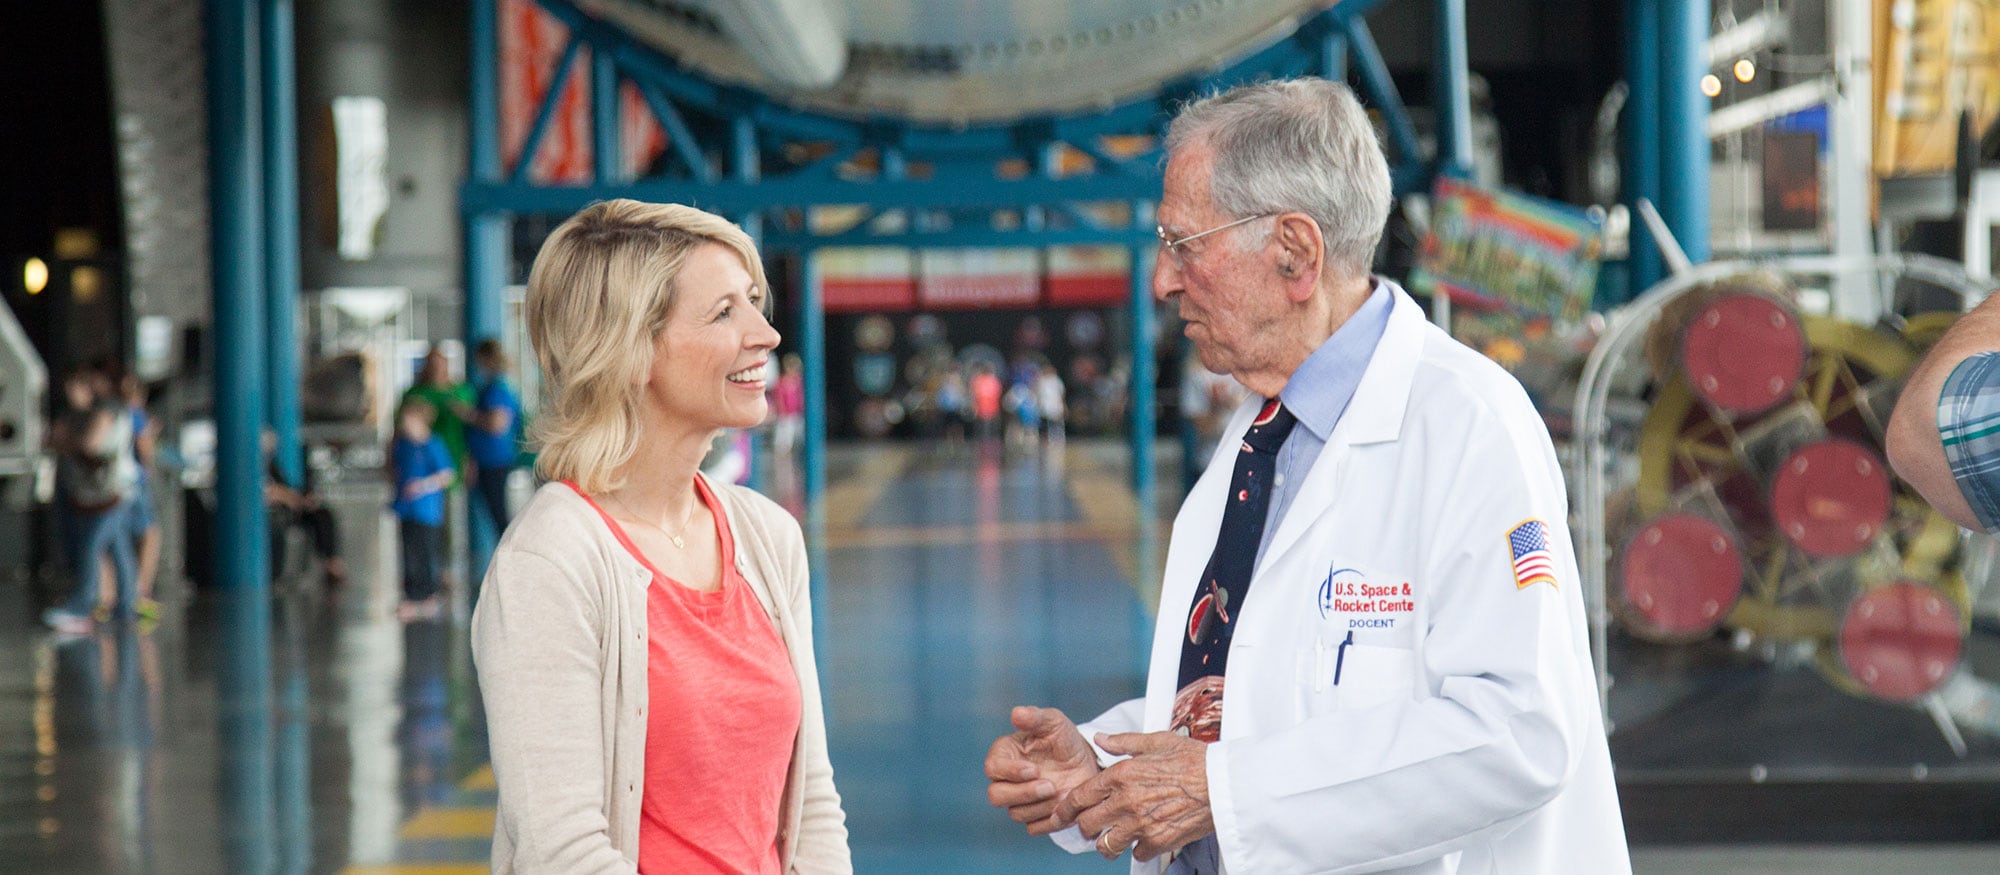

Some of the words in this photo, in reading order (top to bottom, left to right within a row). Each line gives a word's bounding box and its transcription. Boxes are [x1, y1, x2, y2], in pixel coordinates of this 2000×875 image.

[1335, 582, 1358, 596] U.S.
[1361, 583, 1398, 599] Space
[1402, 582, 1411, 596] &
[1334, 598, 1376, 612] Rocket
[1379, 598, 1414, 612] Cente
[1349, 619, 1395, 628] DOCENT
